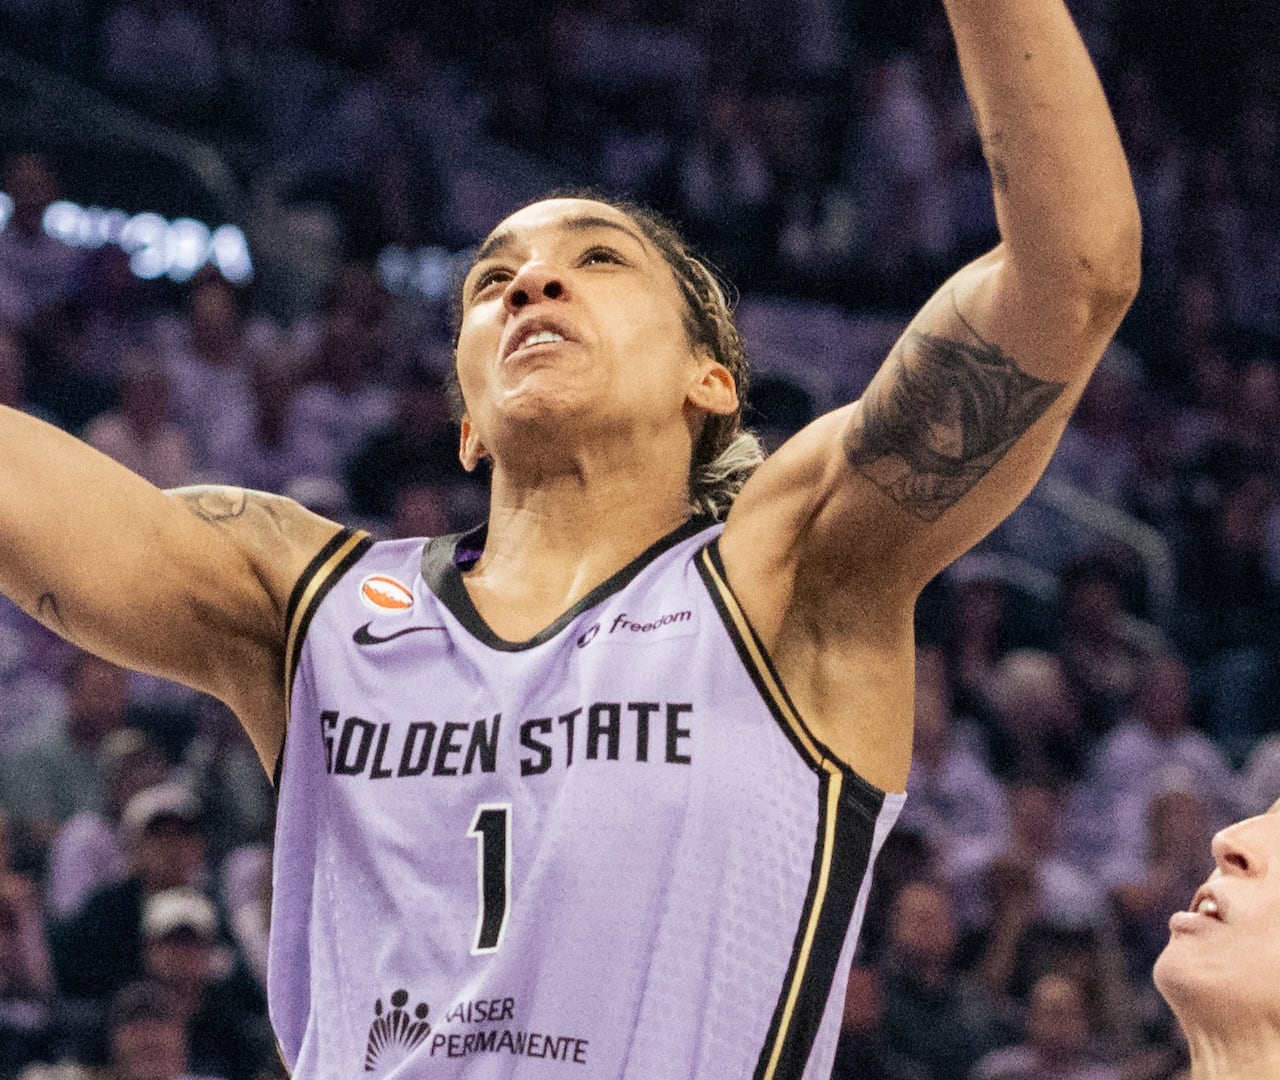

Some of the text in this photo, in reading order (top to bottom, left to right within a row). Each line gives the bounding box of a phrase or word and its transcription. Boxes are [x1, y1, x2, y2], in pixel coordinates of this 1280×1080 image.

[319, 702, 693, 781] GOLDEN STATE
[466, 803, 513, 956] 1
[430, 1029, 589, 1065] PERMANENTE
